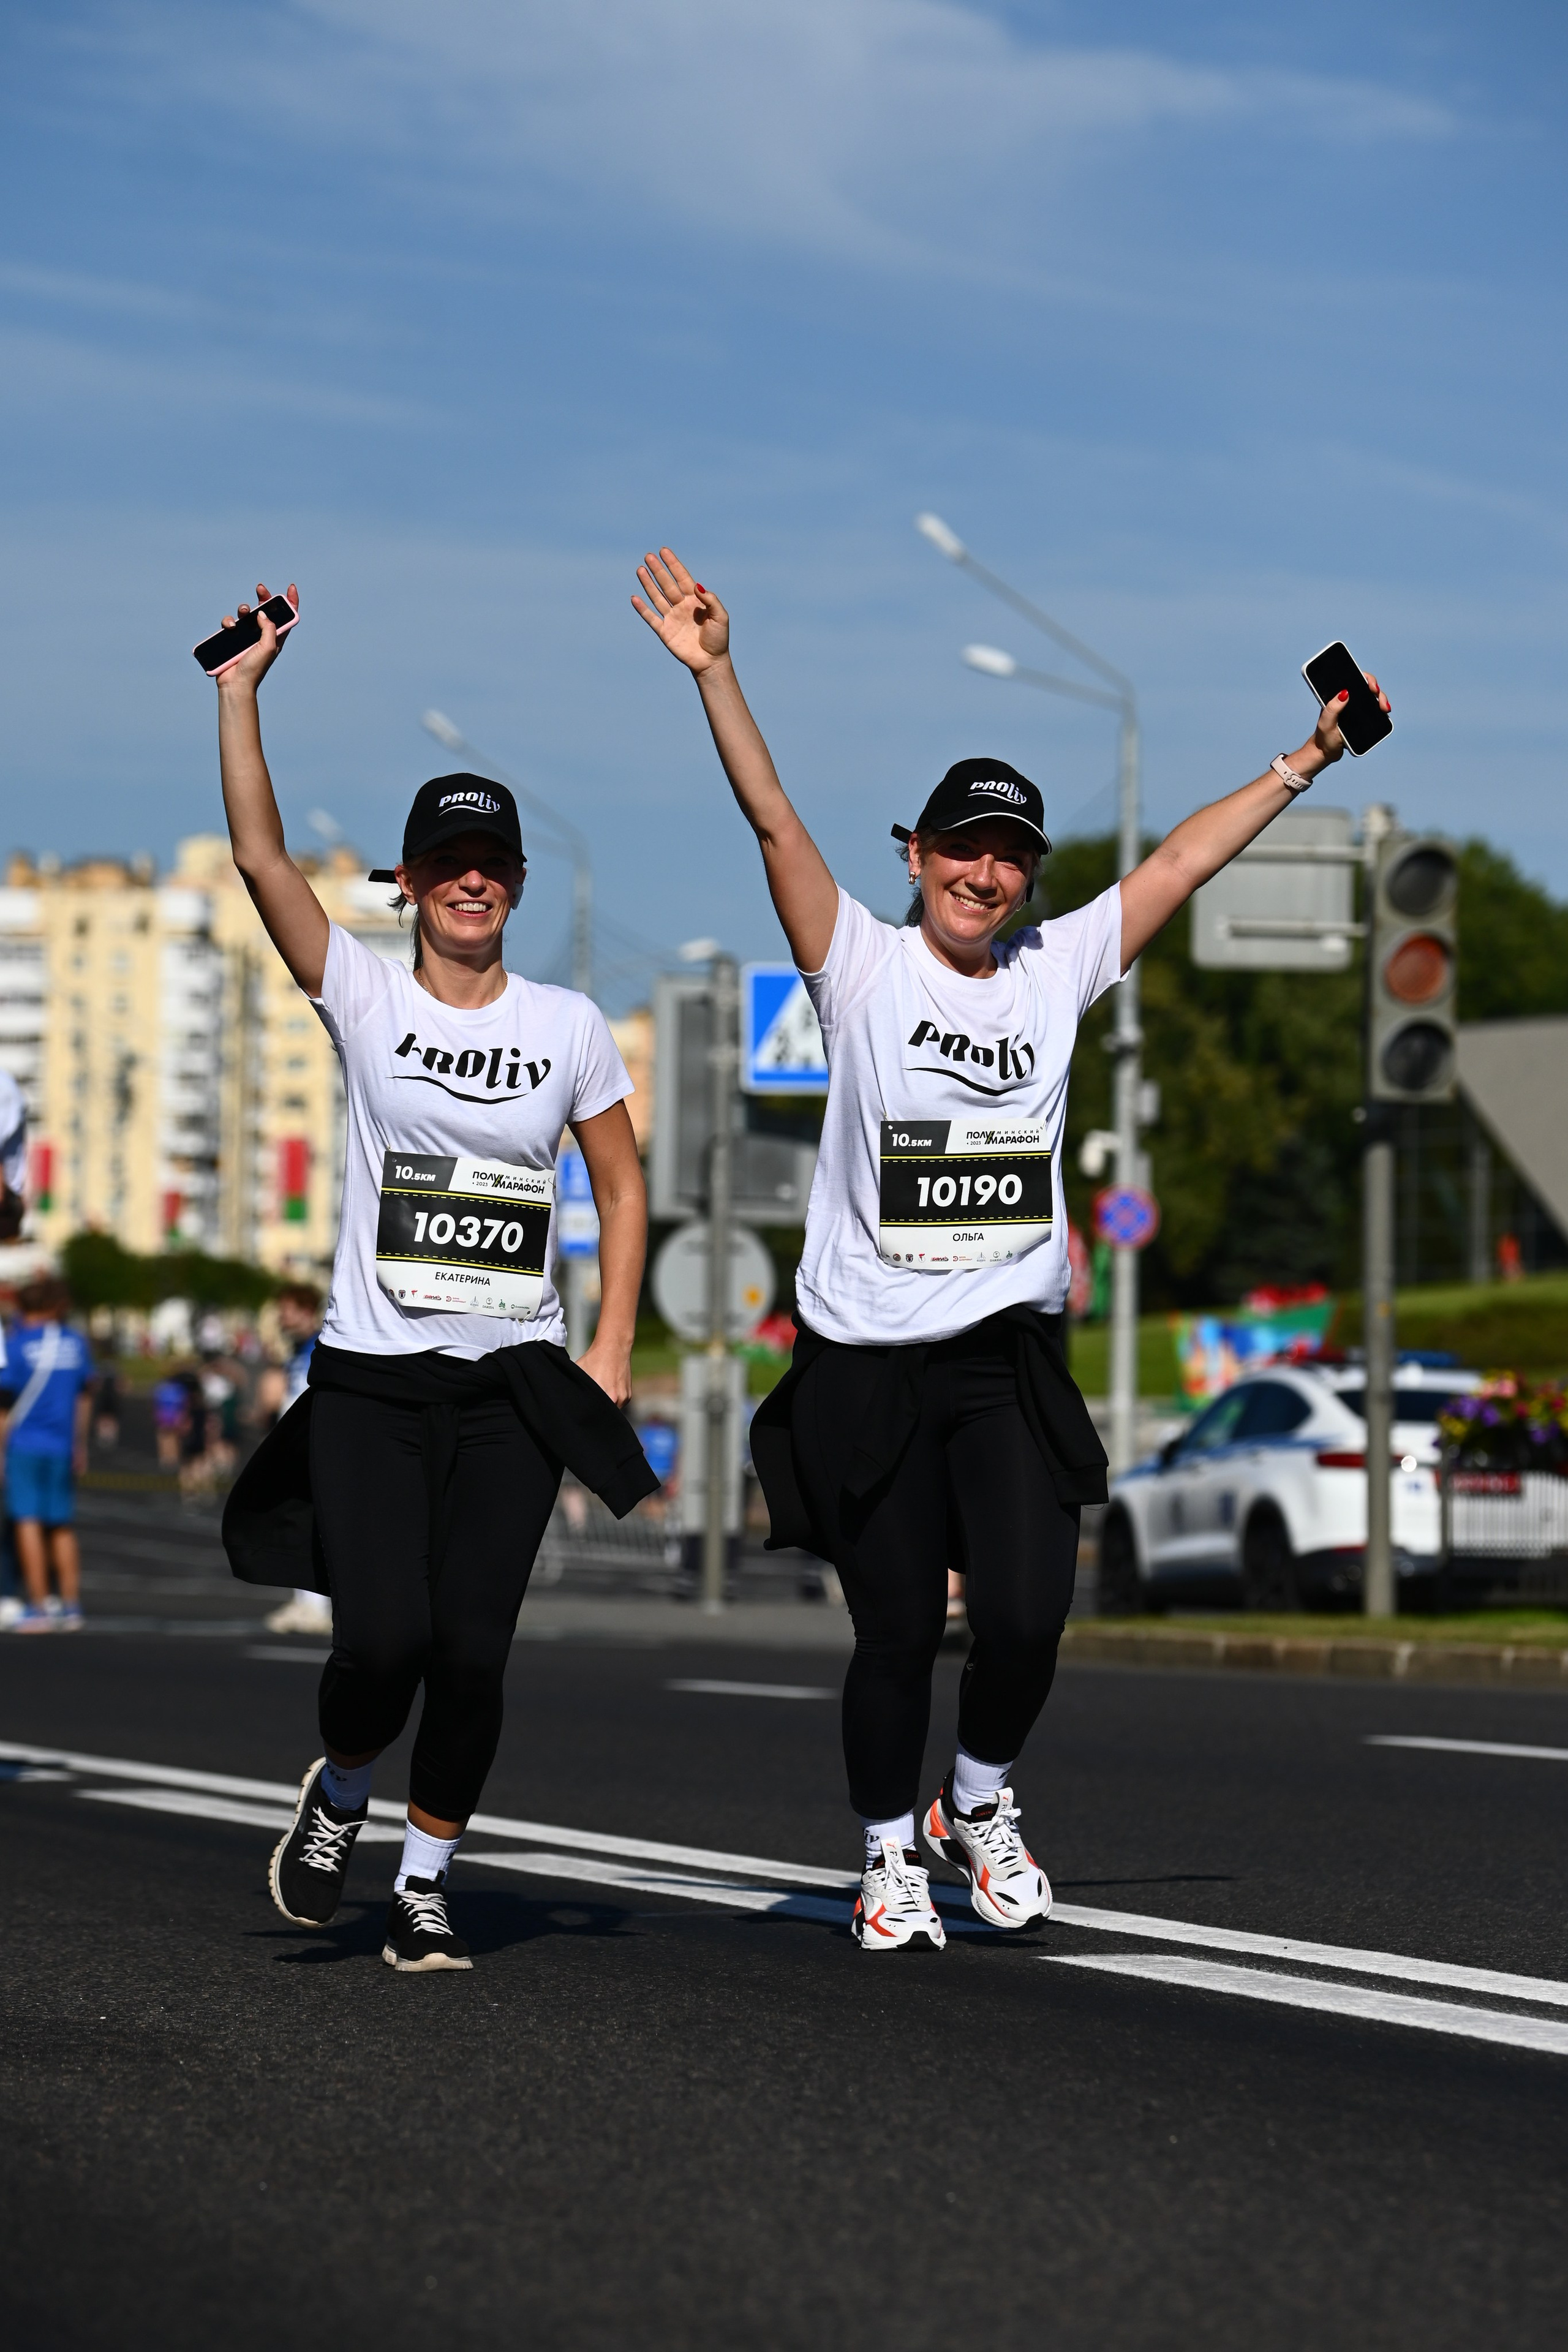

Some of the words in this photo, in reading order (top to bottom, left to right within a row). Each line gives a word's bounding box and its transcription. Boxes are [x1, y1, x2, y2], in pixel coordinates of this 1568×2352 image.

[505, 1175, 546, 1185] МИНСКИЙ
[917, 1174, 1023, 1207] 10190
[414, 1212, 524, 1253] 10370
[952, 1232, 984, 1242] ОЛЬГА
[434, 1272, 491, 1286] ЕКАТЕРИНА
